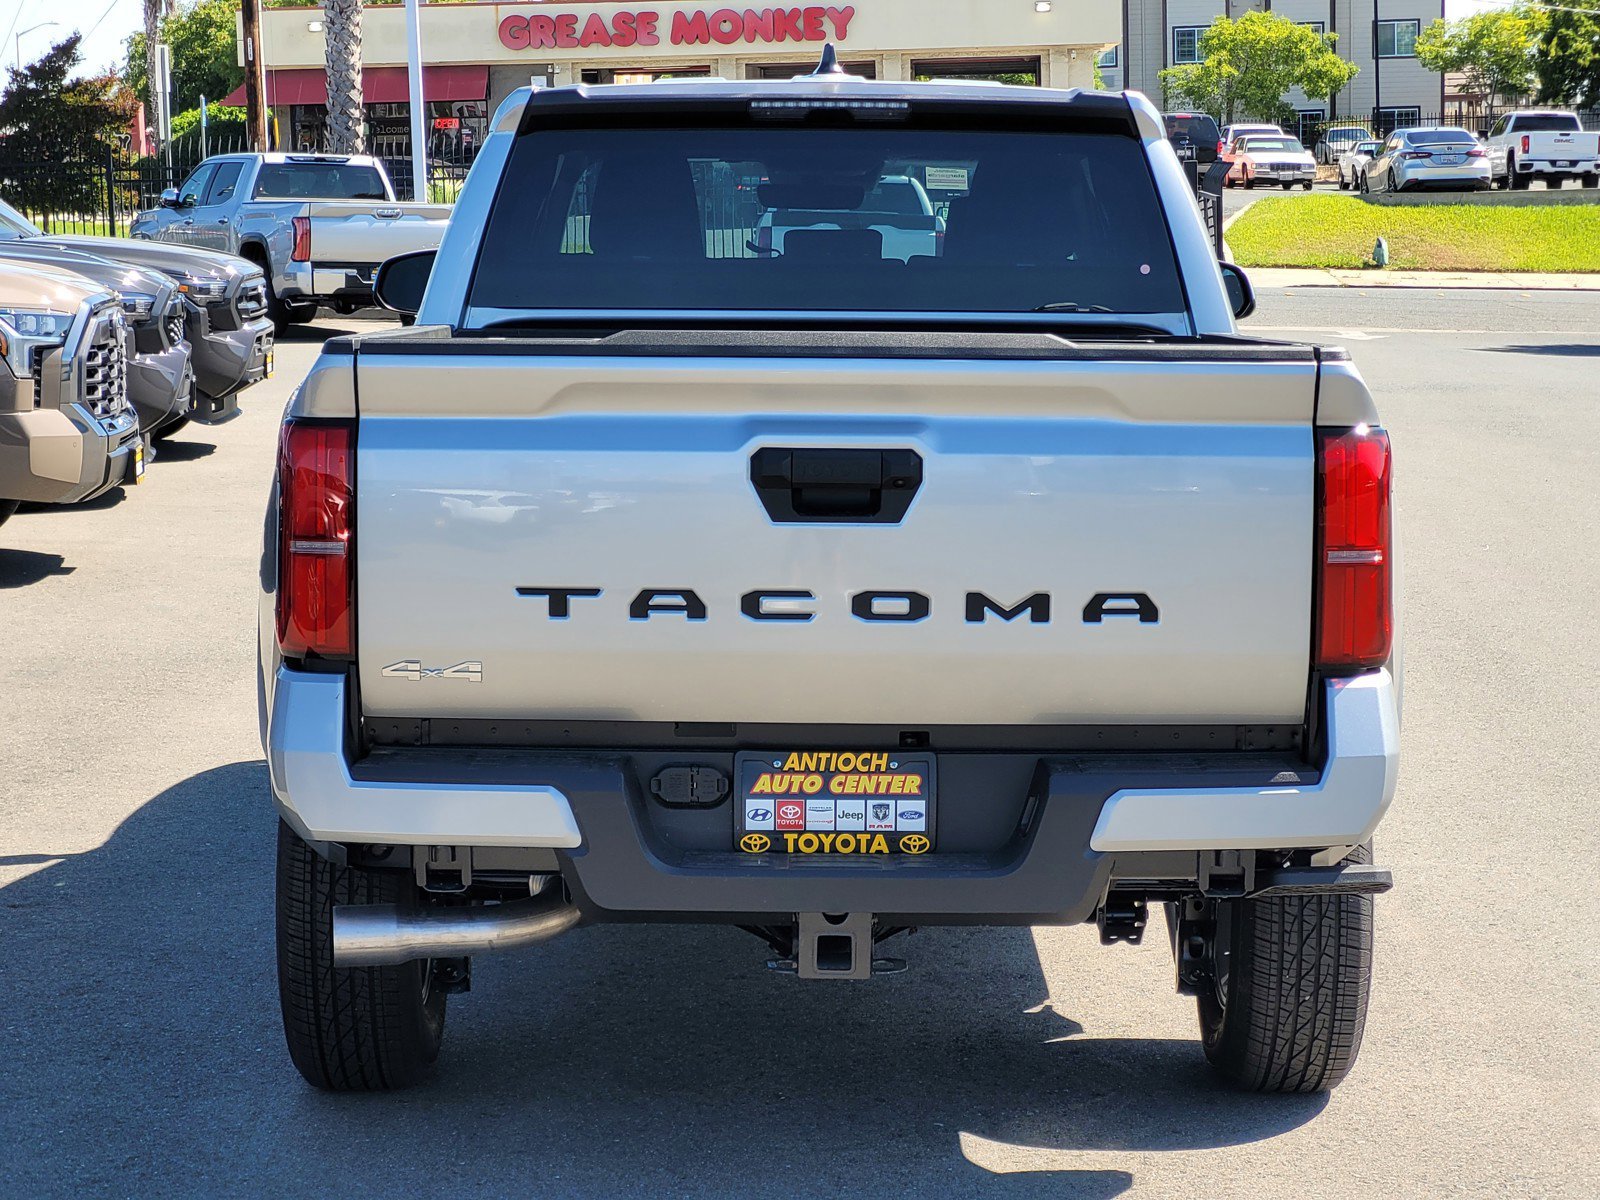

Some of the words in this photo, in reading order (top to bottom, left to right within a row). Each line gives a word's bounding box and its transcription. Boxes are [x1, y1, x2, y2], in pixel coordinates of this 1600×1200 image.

[498, 11, 660, 50] GREASE
[670, 6, 855, 45] MONKEY
[374, 125, 410, 134] elcome
[436, 119, 459, 128] OPEN
[515, 587, 1160, 623] TACOMA
[382, 660, 482, 682] 4x4
[783, 752, 889, 772] ANTIOCH
[751, 774, 824, 794] AUTO
[829, 774, 922, 795] CENTER
[838, 810, 863, 821] Jeep
[784, 833, 890, 853] TOYOTA
